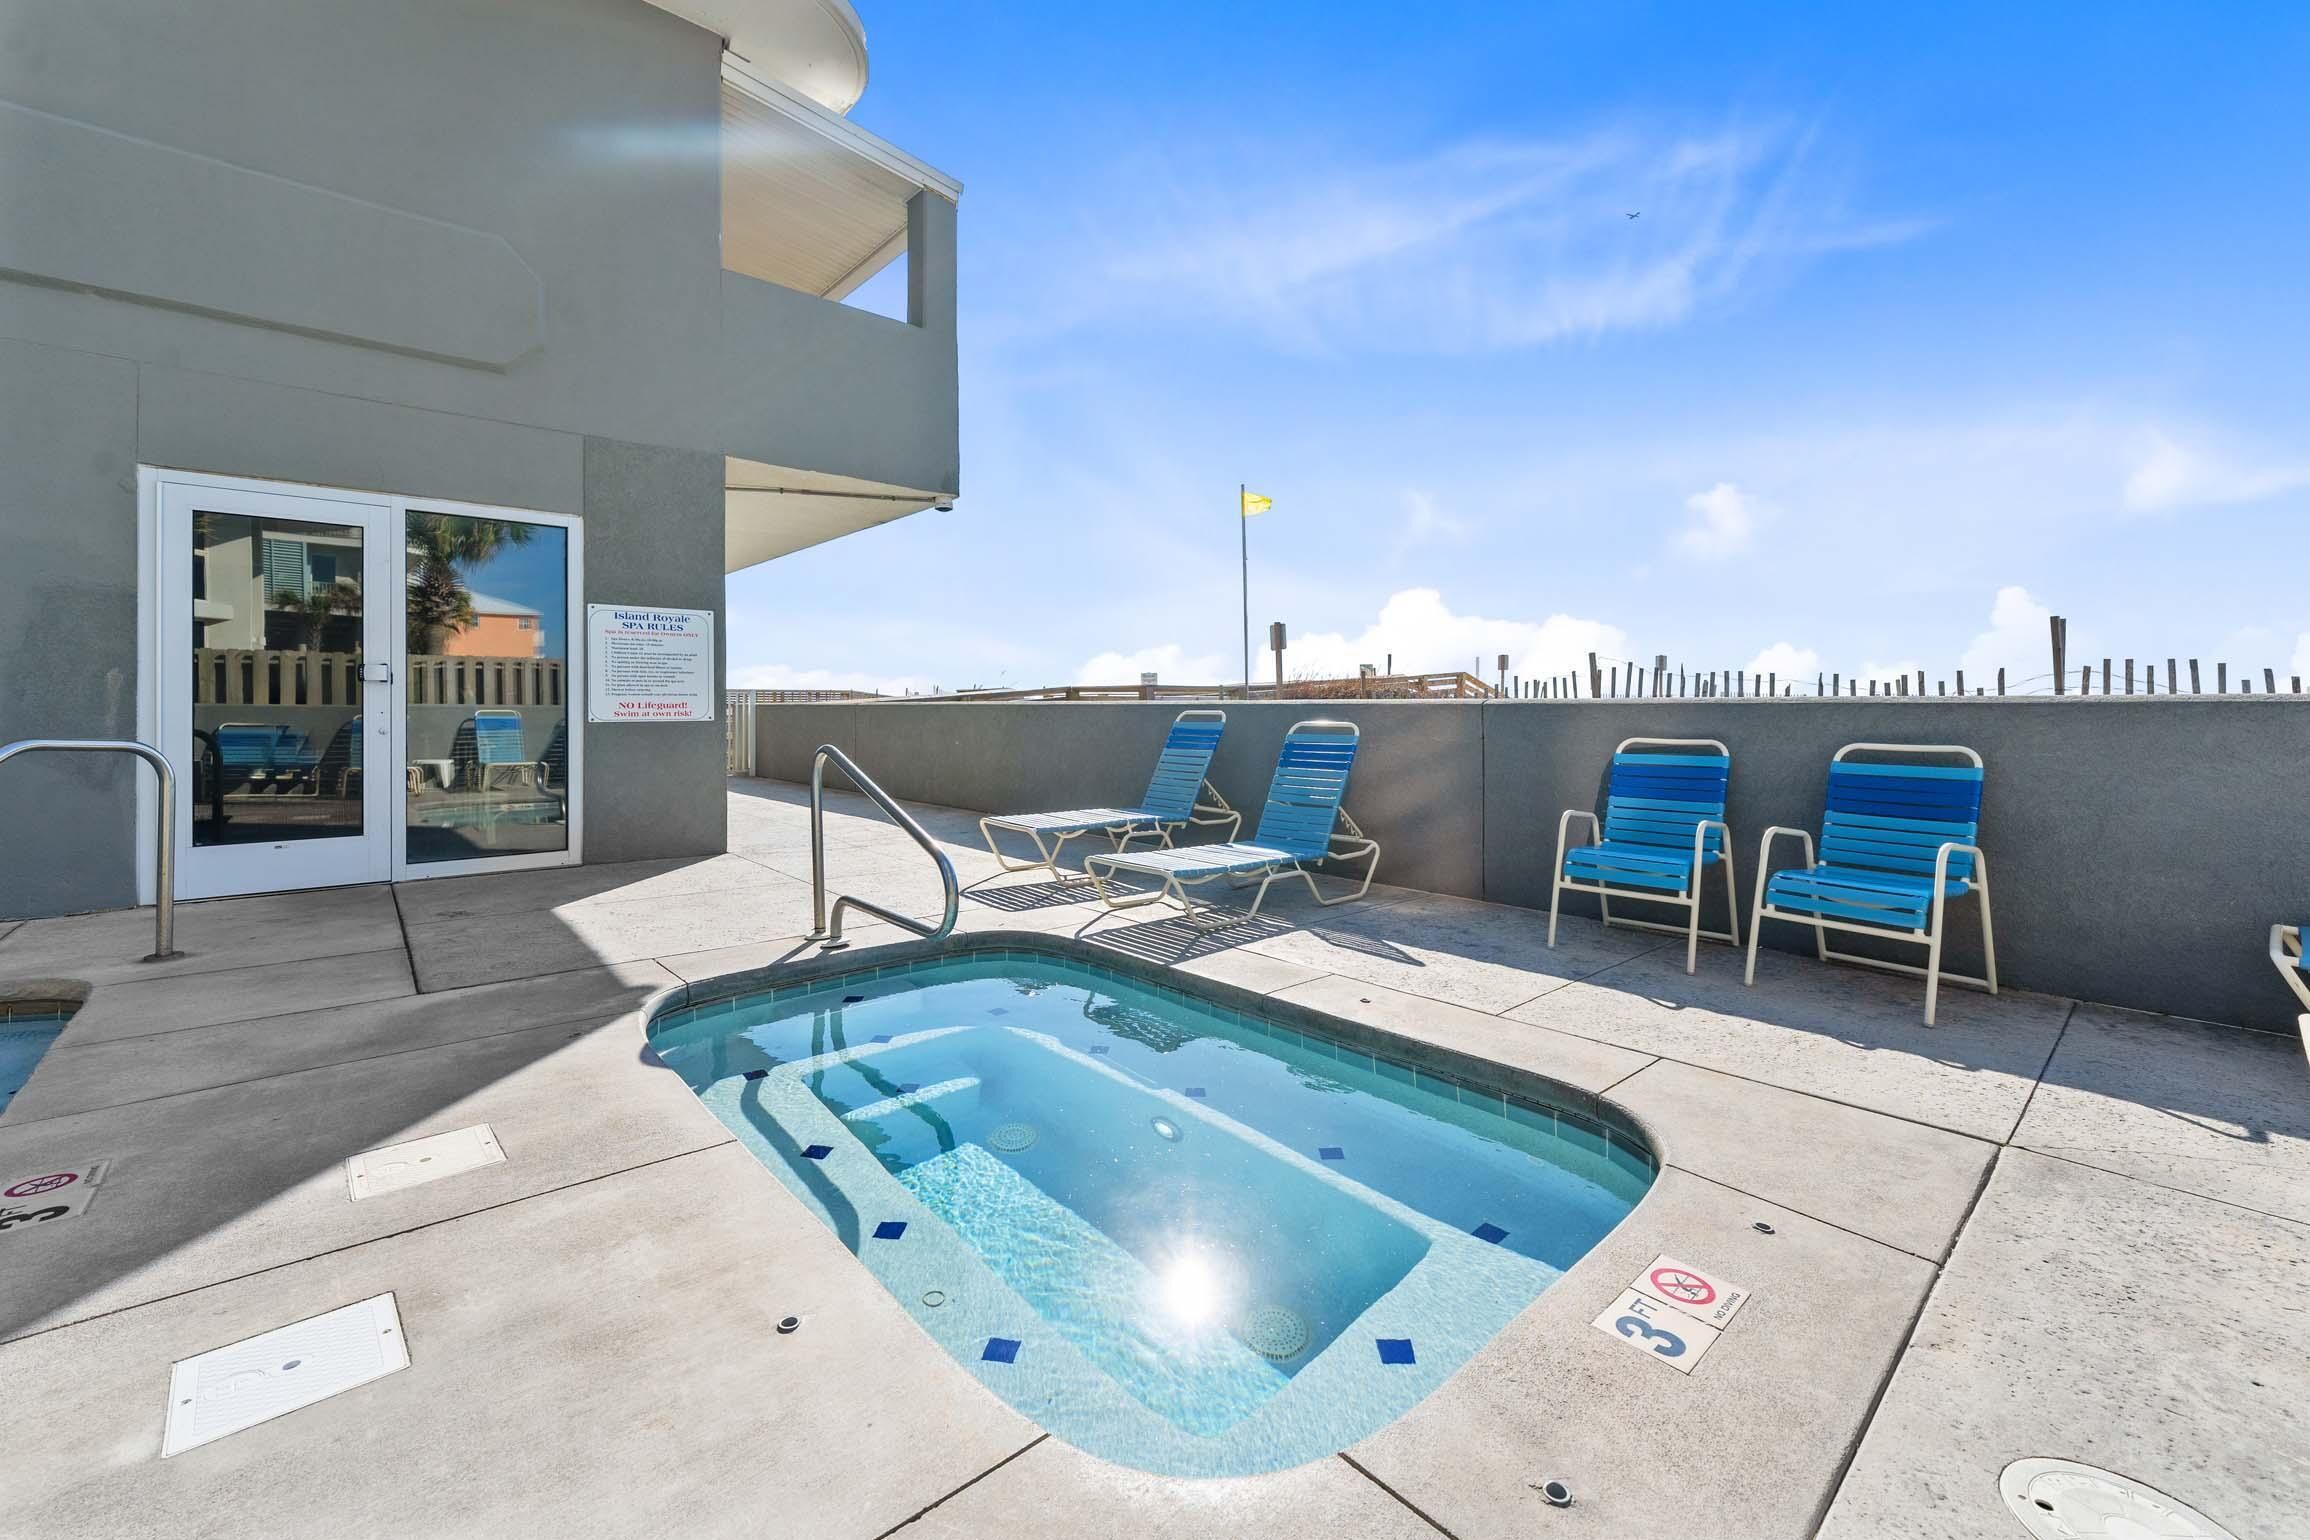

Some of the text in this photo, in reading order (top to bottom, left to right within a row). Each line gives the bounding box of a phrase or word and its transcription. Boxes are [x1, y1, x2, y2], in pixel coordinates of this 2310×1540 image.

[614, 611, 691, 624] Island Royale
[622, 621, 684, 632] SPA RULES
[638, 702, 688, 710] Lifeguard!
[1713, 1292, 1741, 1320] NO DIVING
[1615, 1298, 1687, 1357] 3 FT
